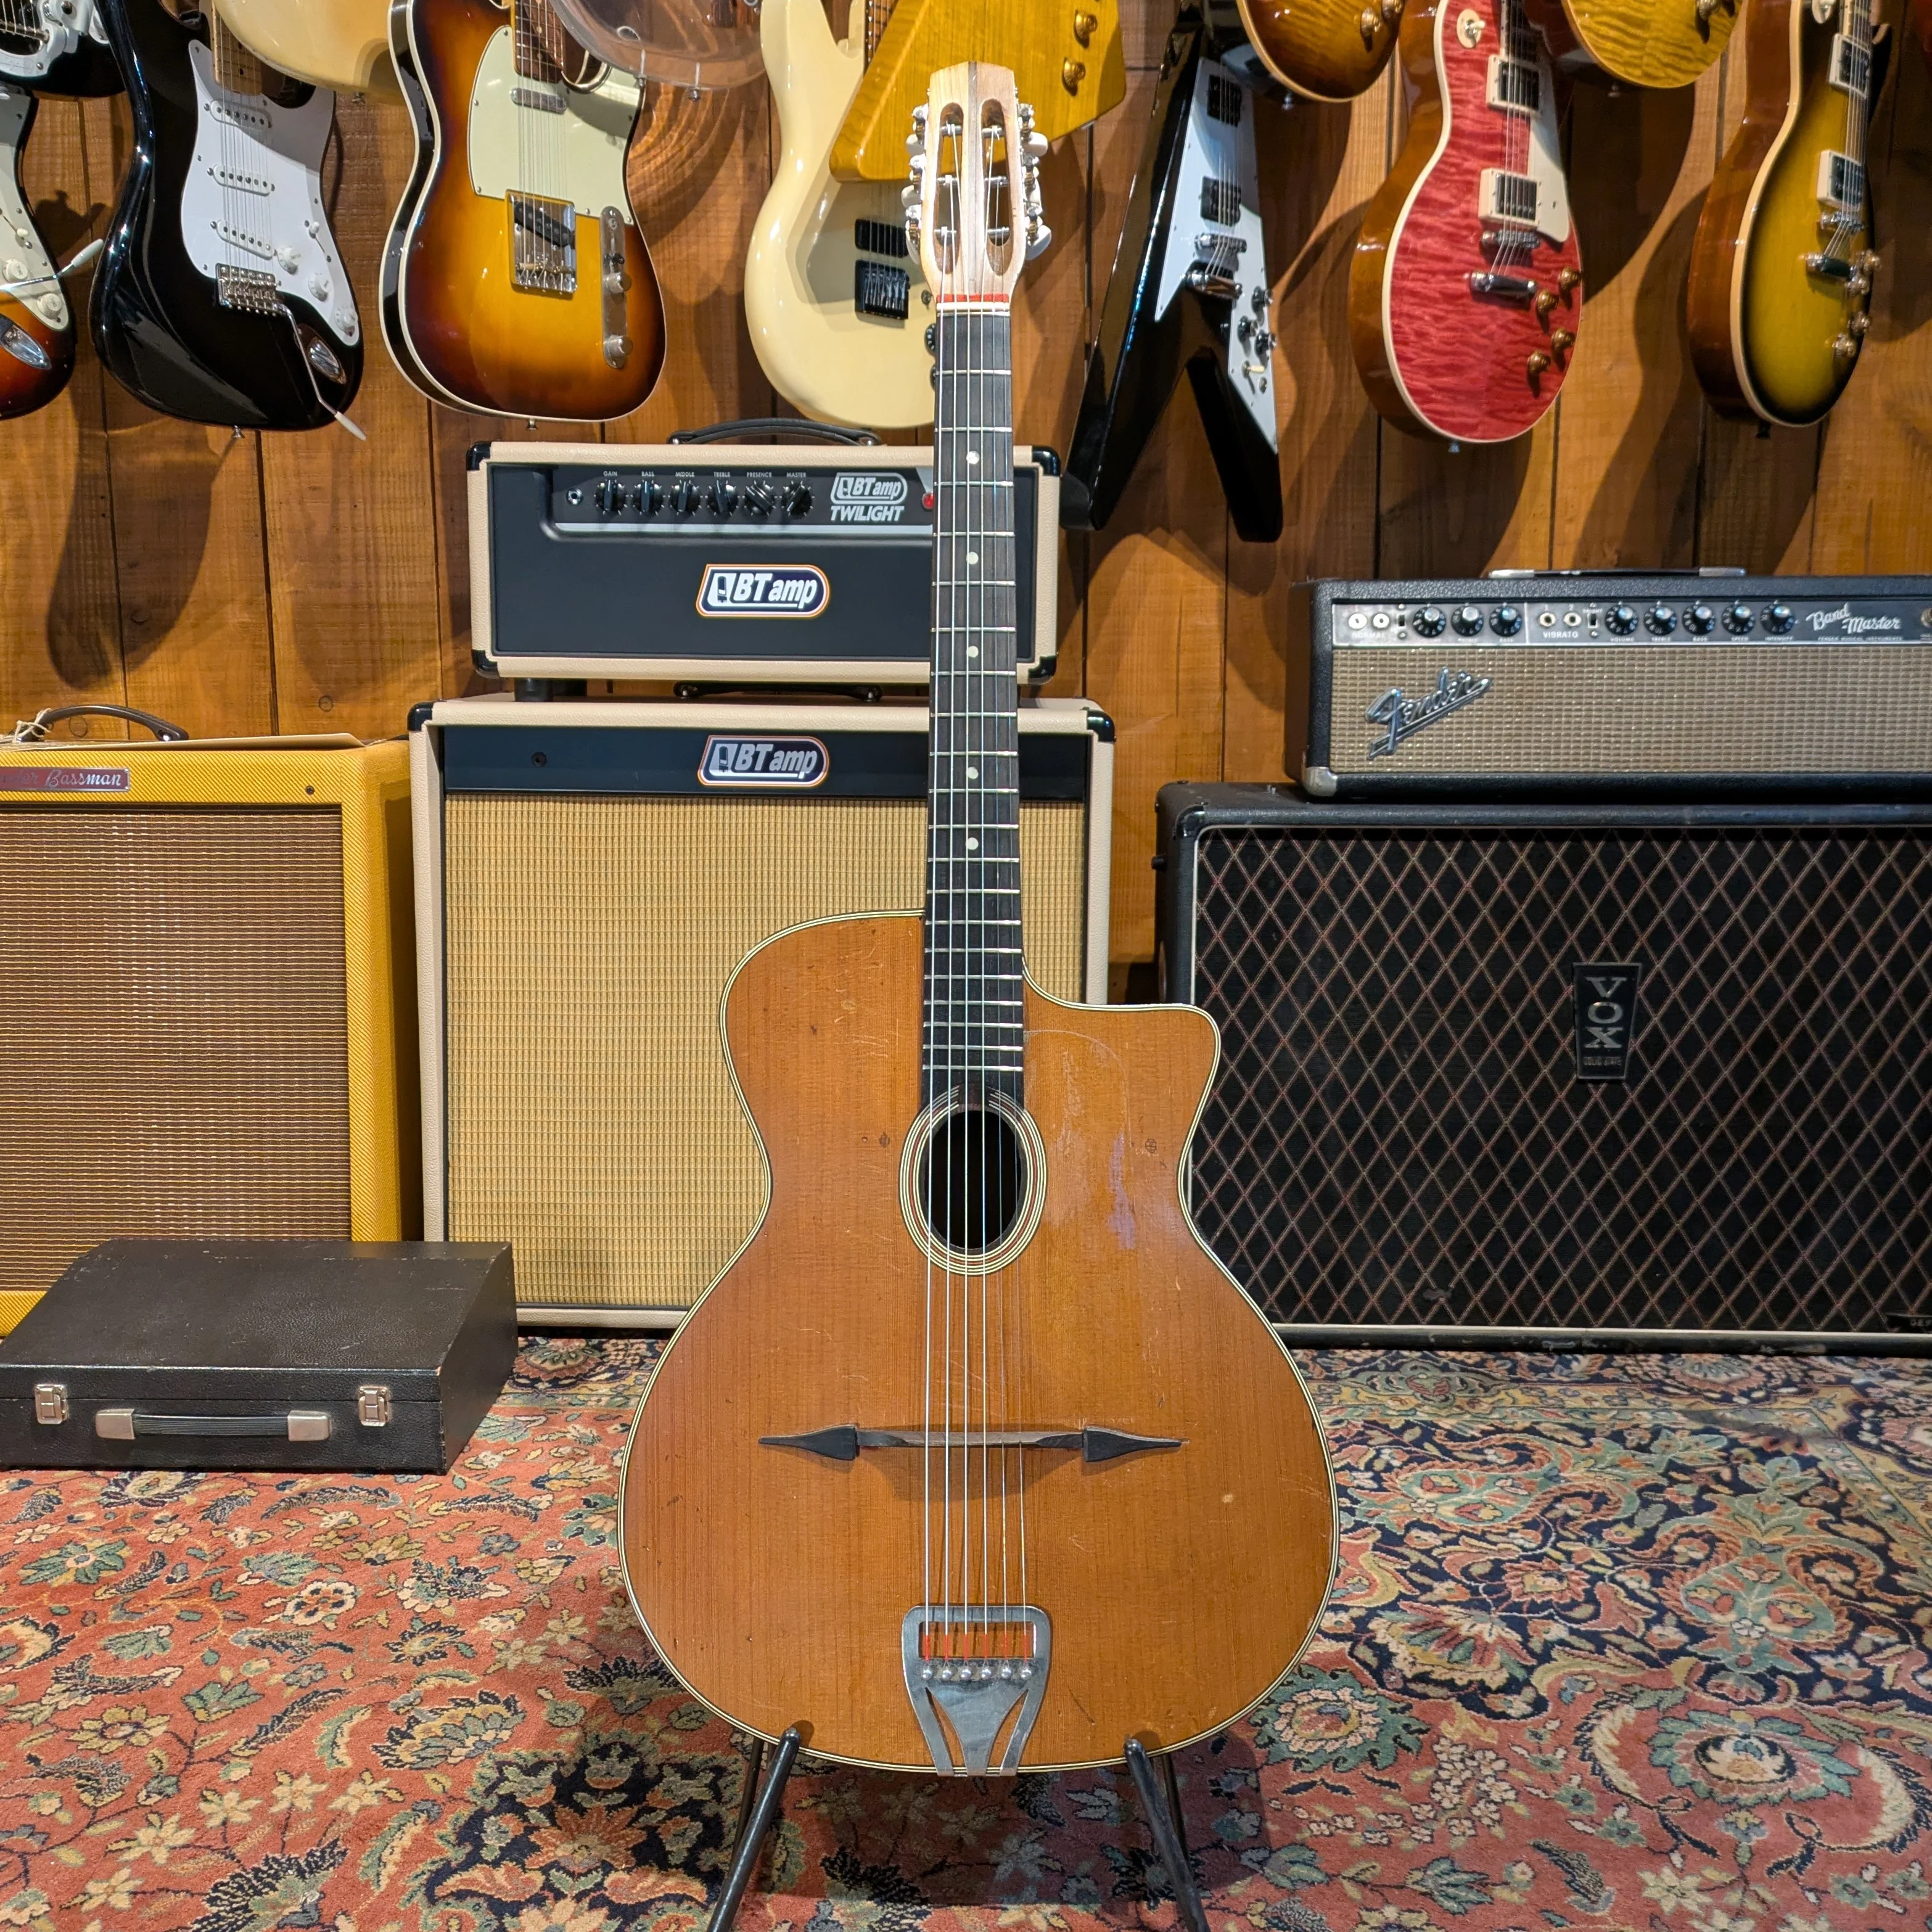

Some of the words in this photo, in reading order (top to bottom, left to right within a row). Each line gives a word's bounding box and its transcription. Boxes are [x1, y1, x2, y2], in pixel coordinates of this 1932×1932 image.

[830, 505, 905, 522] TWILIGHT
[1805, 602, 1851, 631] Band
[1841, 615, 1902, 635] Master
[1365, 666, 1492, 758] Fender
[44, 769, 121, 788] Bassman
[1584, 976, 1627, 1048] VOX
